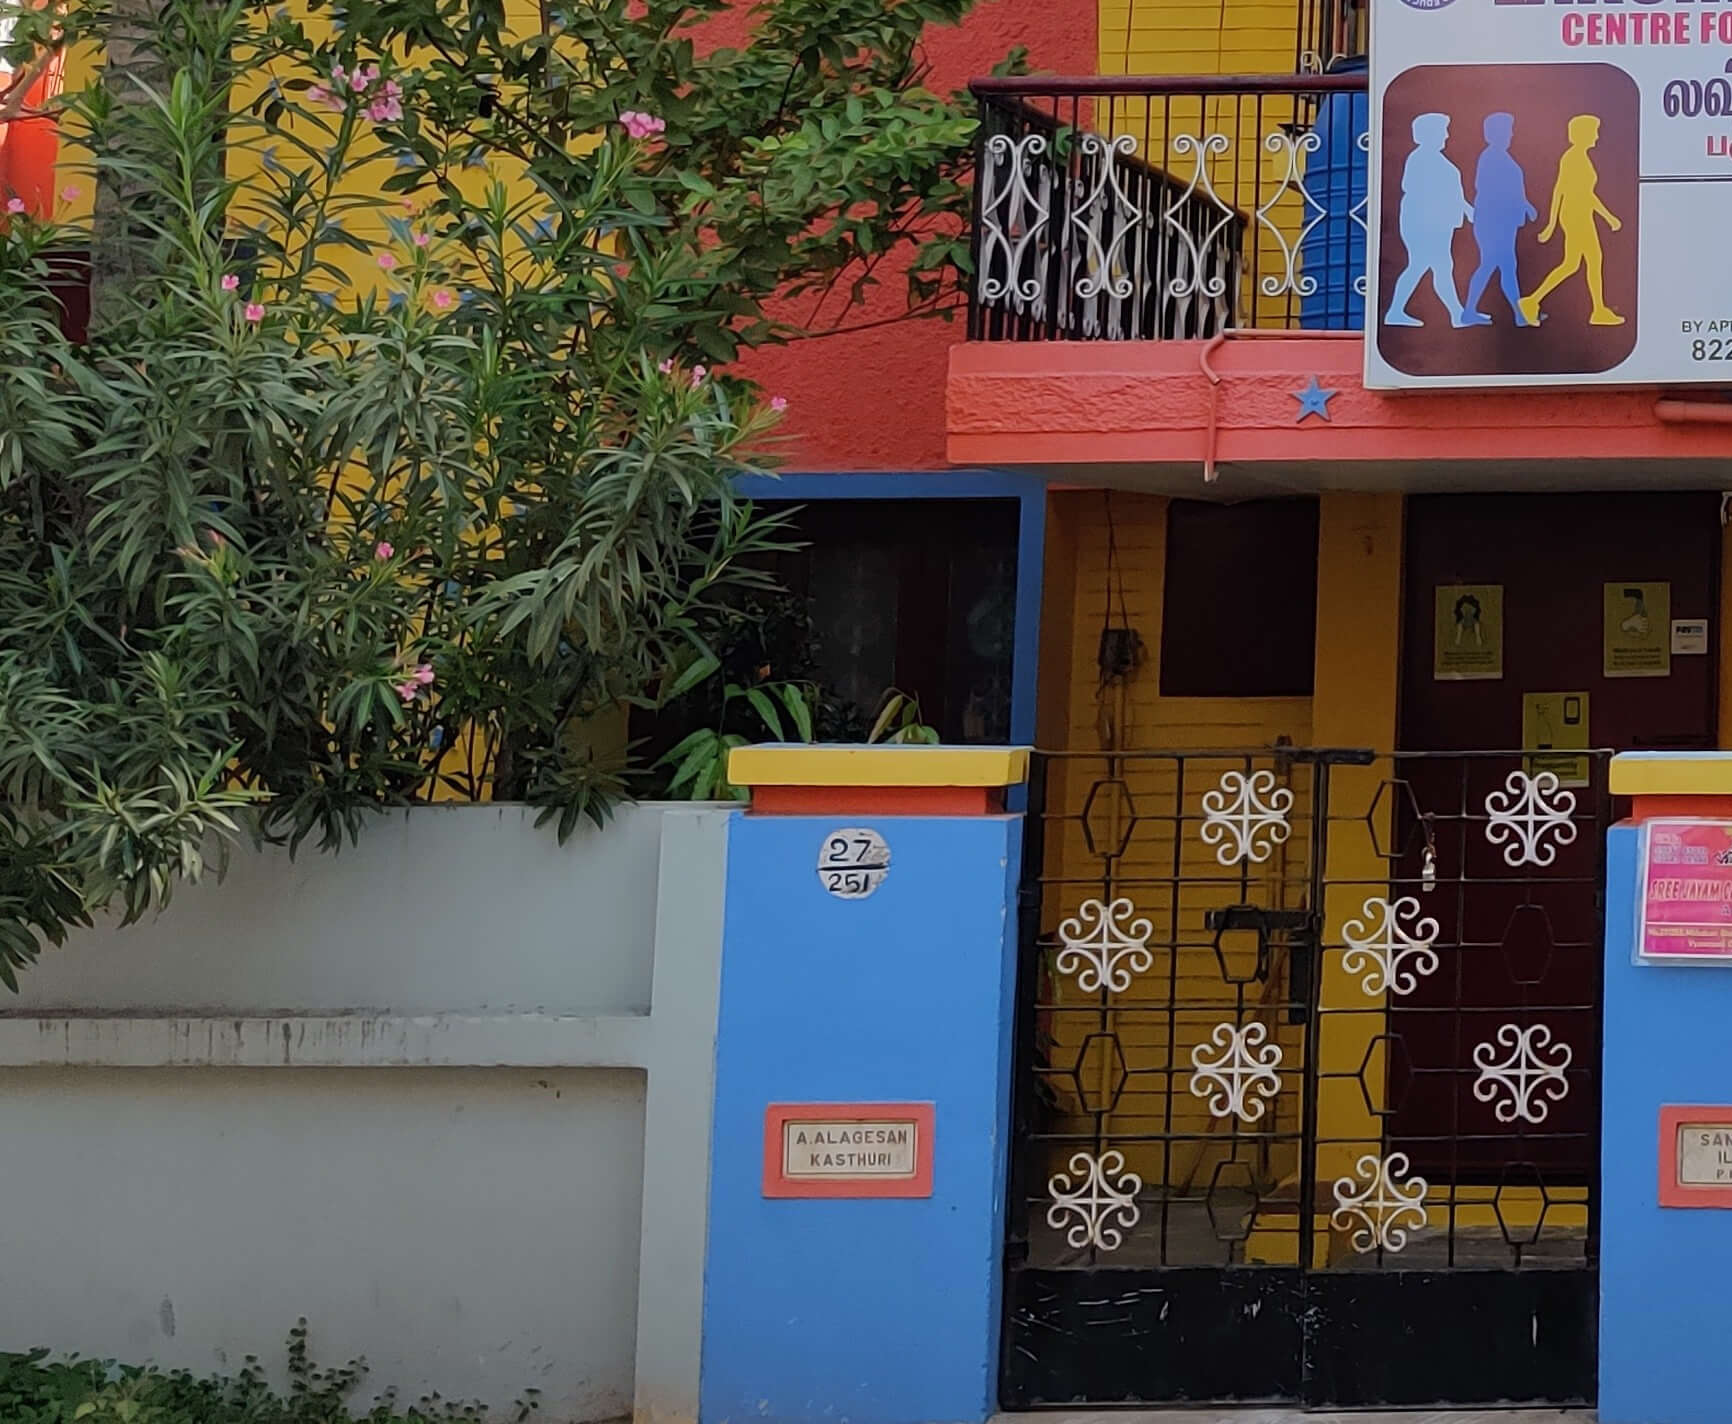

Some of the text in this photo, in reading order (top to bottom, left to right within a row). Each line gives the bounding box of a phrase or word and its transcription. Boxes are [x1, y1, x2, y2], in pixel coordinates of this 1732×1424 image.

[1561, 11, 1691, 46] CENTRE
[1681, 319, 1703, 334] BY
[828, 838, 872, 863] 27
[828, 873, 870, 893] 251
[1650, 880, 1680, 900] SREE
[796, 1129, 908, 1145] A.ALAGESAN
[810, 1152, 892, 1167] KASTHURI
